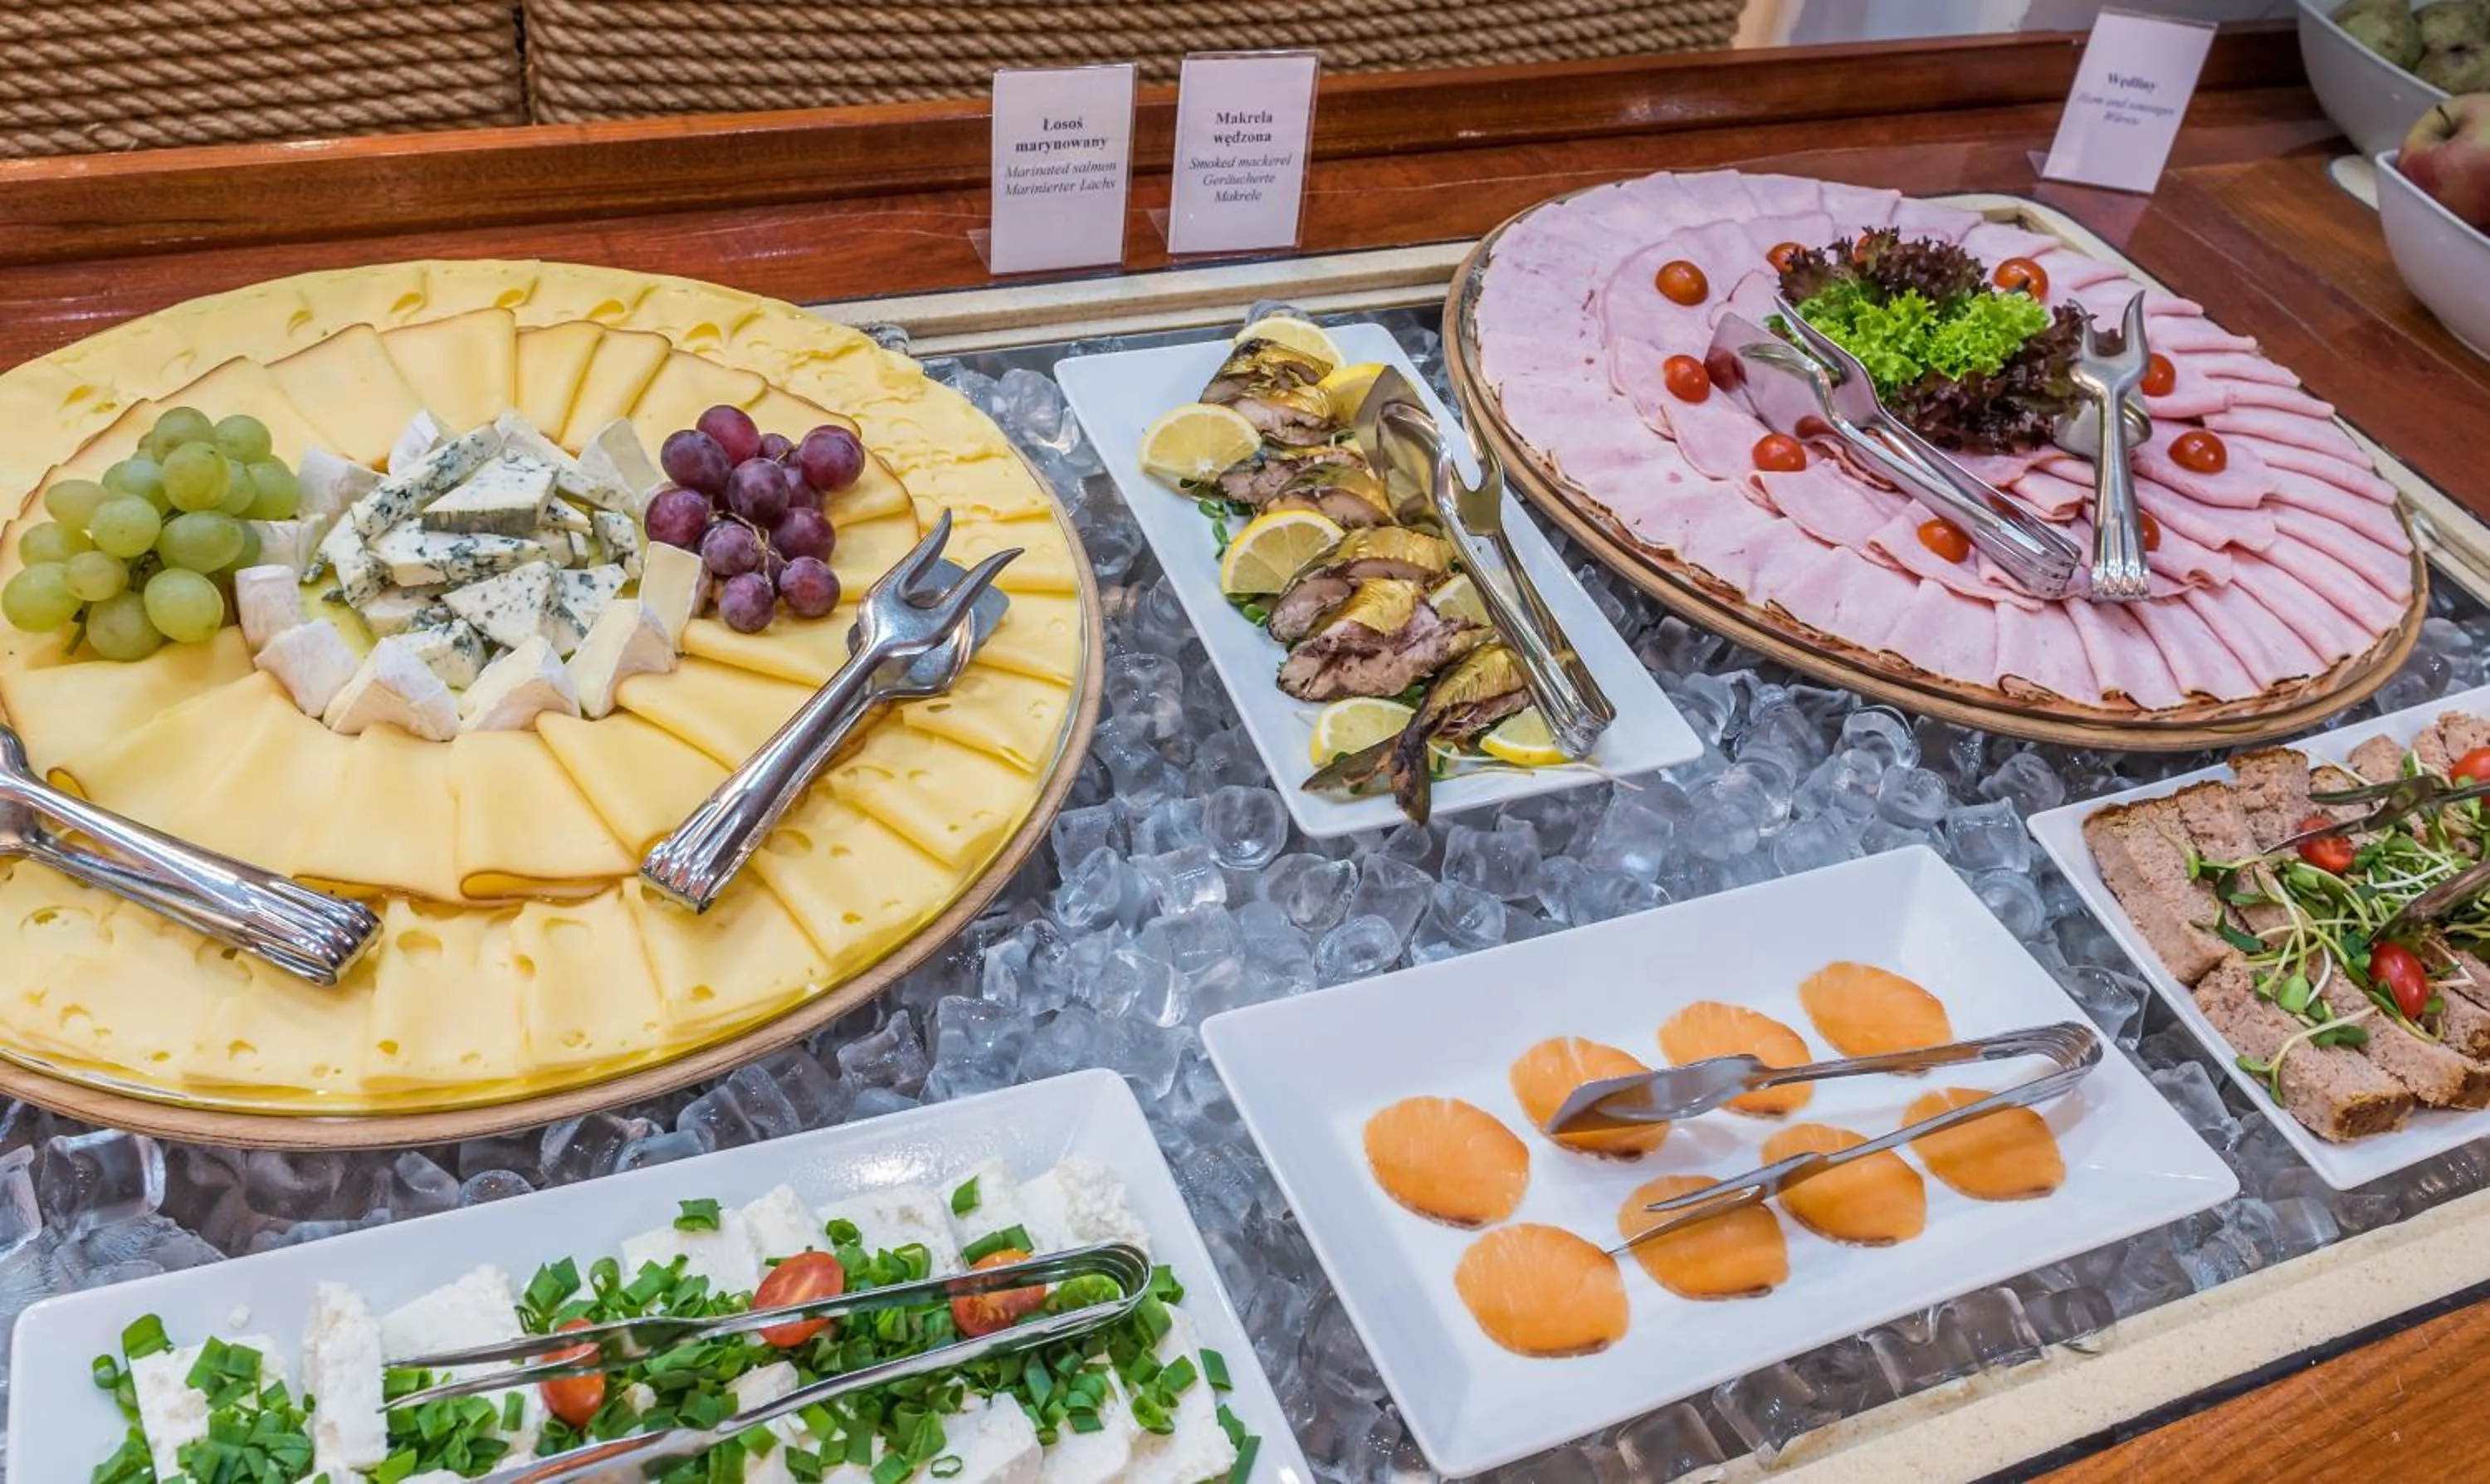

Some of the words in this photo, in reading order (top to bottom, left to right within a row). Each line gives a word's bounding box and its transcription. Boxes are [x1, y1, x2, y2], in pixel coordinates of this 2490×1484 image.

[1042, 115, 1084, 131] Łosoś
[1216, 110, 1273, 125] Makrela
[1015, 137, 1108, 154] marynowany
[1213, 130, 1272, 147] wędzona
[1189, 156, 1236, 170] Smoked
[1238, 154, 1292, 168] mackerel
[1006, 164, 1070, 178] Marinated
[1072, 163, 1117, 173] salmon
[1004, 182, 1076, 196] Marinierter
[1081, 178, 1116, 192] Lachs
[1203, 173, 1276, 187] Geräucherte
[1214, 189, 1262, 203] Makrele
